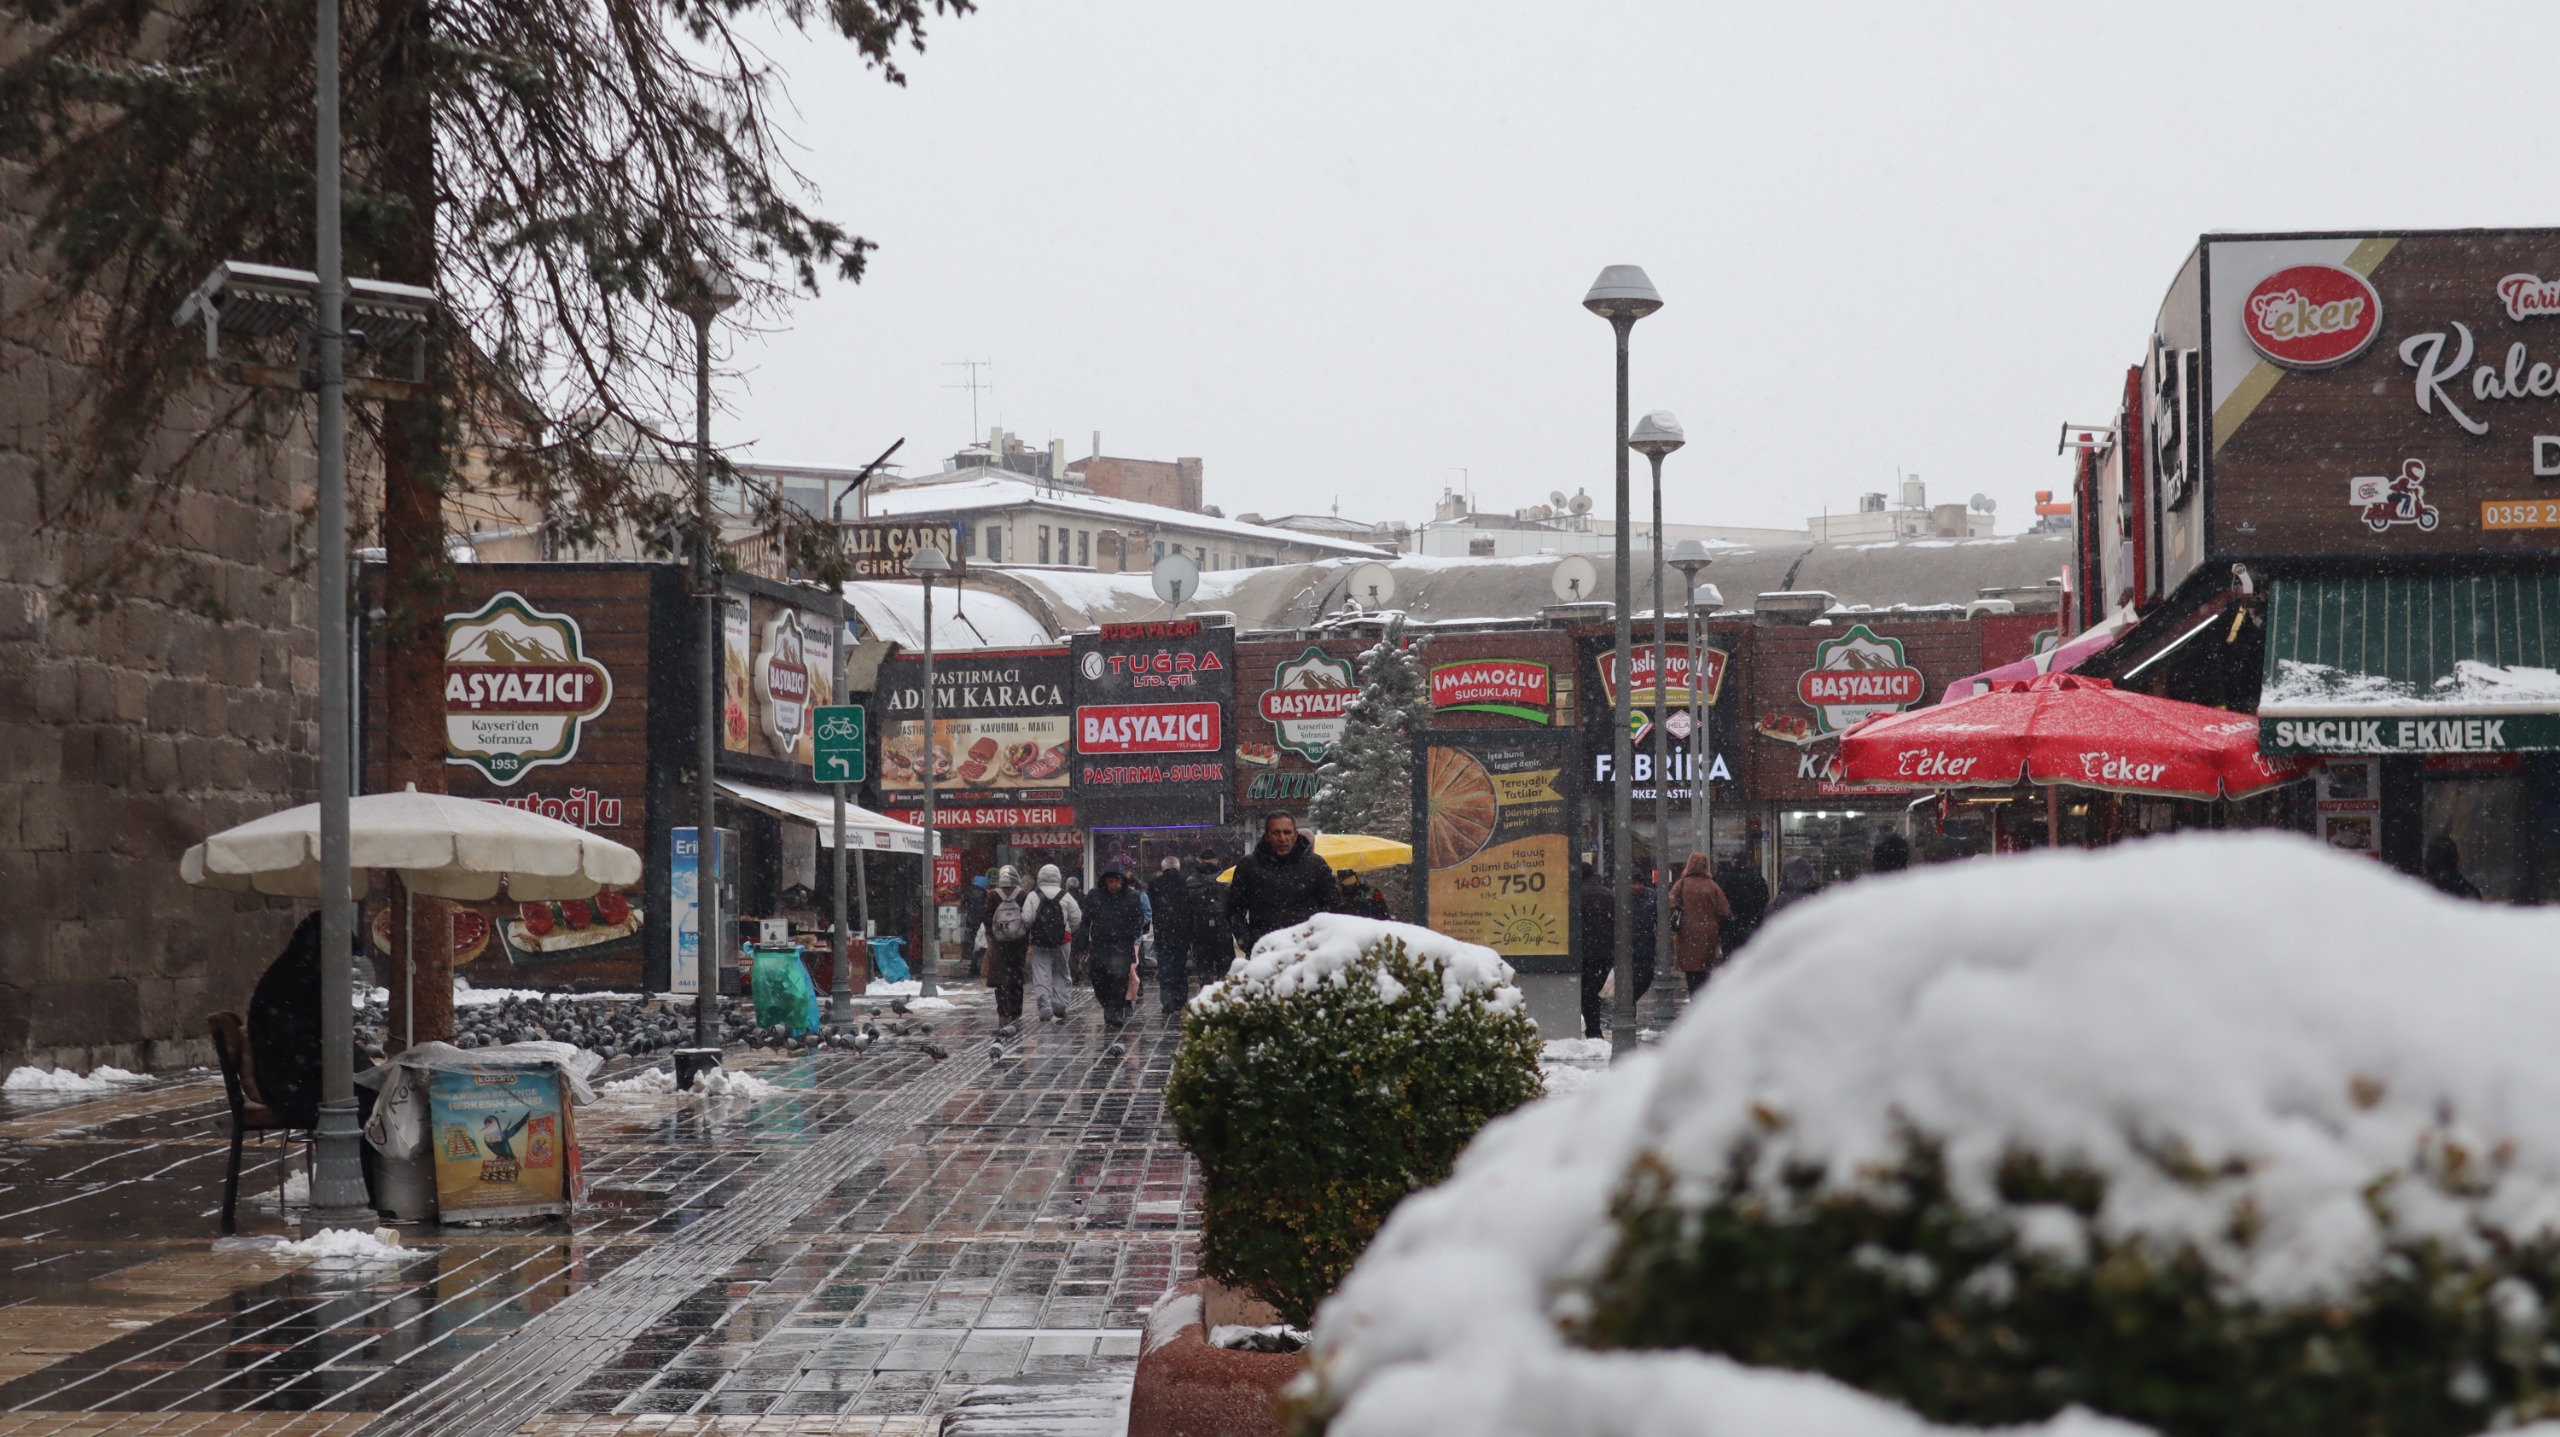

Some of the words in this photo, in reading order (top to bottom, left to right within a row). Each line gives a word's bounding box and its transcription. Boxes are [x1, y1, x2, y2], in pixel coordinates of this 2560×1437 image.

[2399, 321, 2560, 435] Kale
[2487, 505, 2539, 524] 0352
[1101, 623, 1145, 640] BURSA
[1150, 620, 1199, 638] PAZARI
[1107, 649, 1224, 675] TUĞRA
[770, 666, 804, 695] BAŞYAZICI
[931, 669, 1020, 685] PASTIRMACI
[1133, 675, 1166, 688] LTD.
[1168, 671, 1197, 690] ŞTİ.
[1434, 668, 1541, 692] İMAMOĞLU
[446, 672, 584, 708] AŞYAZICI
[963, 684, 1064, 708] KARACA
[1455, 687, 1522, 700] SUCUKLARI
[1811, 675, 1910, 700] BAŞYAZICI
[472, 719, 539, 733] Kayseri'den
[945, 723, 972, 735] SUCUK
[980, 722, 1020, 734] KAVURMA
[1028, 721, 1054, 732] MANTI
[1084, 713, 1209, 749] BAŞYAZICI
[1297, 722, 1334, 731] Kayseri'den
[2276, 720, 2382, 748] SUCUK
[2398, 719, 2506, 748] EKMEK
[478, 733, 533, 745] Sofranıza
[490, 759, 519, 770] 1953
[1247, 773, 1320, 799] ALTIN
[1500, 775, 1548, 788] Tereyağlı
[1504, 789, 1543, 799] Tatlılar
[975, 808, 1018, 825] SATIŞ
[1021, 808, 1056, 824] YERİ
[1512, 849, 1545, 858] Havuç
[936, 866, 956, 884] 750
[1471, 863, 1501, 873] Dilimi
[1454, 875, 1492, 890] 1400
[1498, 871, 1546, 895] 750
